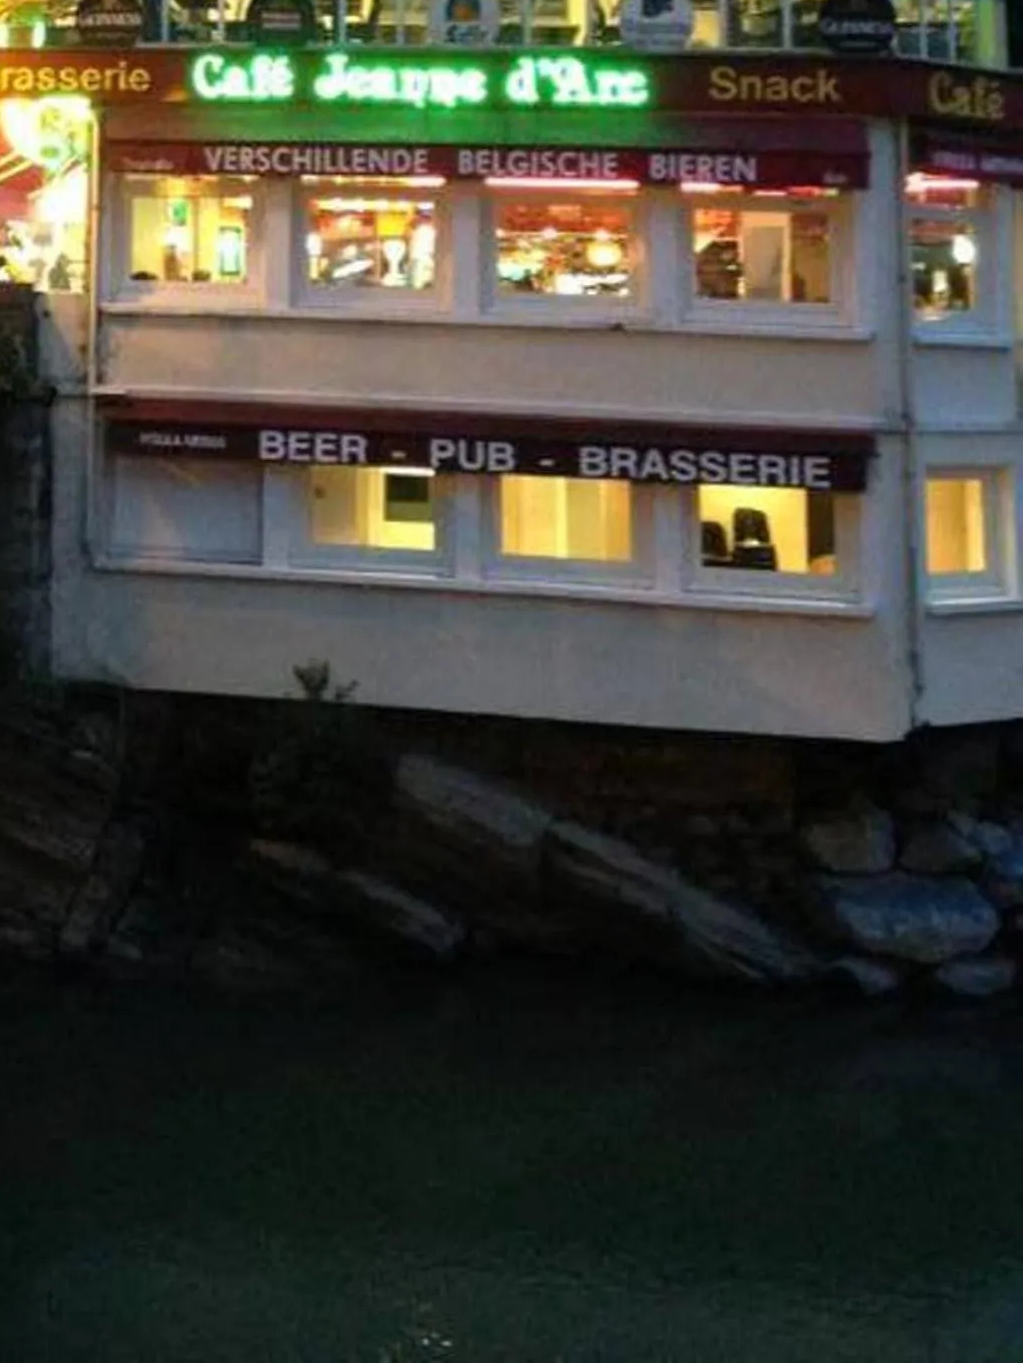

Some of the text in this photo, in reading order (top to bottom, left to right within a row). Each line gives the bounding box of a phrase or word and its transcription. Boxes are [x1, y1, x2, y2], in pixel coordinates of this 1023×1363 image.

[192, 52, 650, 107] Café Jeanne d'Arc
[709, 65, 843, 103] Snack
[930, 72, 1006, 120] Café
[204, 146, 429, 174] VERSCHILLENDE
[457, 149, 619, 179] BELGISCHE
[648, 153, 757, 182] BIEREN
[258, 429, 369, 463] BEER
[428, 438, 517, 471] PUB
[578, 445, 832, 487] BRASSERIE
